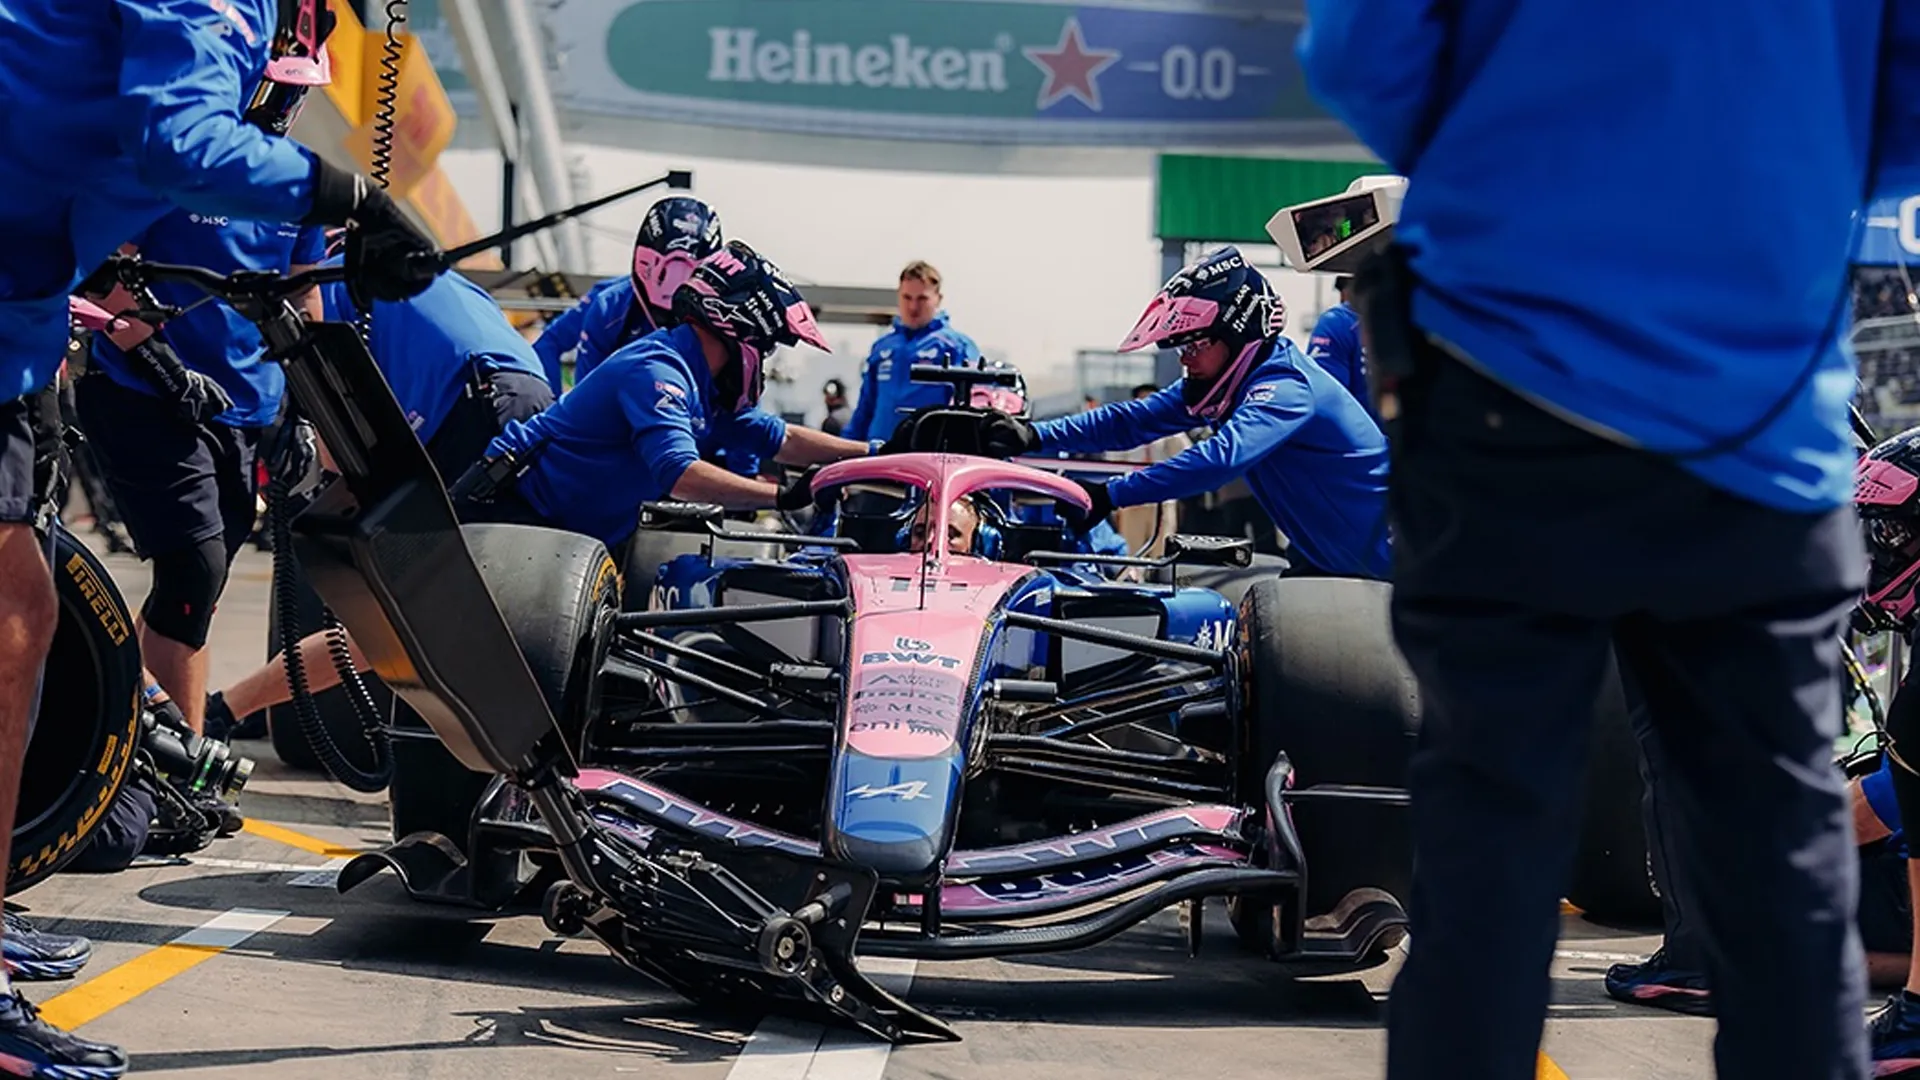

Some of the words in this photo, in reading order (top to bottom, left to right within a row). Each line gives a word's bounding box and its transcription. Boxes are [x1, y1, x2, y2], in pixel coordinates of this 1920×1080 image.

[708, 27, 1008, 91] Heineken
[1205, 255, 1243, 277] MSC
[65, 552, 130, 647] PIRELLI
[861, 652, 961, 669] BWT
[849, 718, 900, 732] eni
